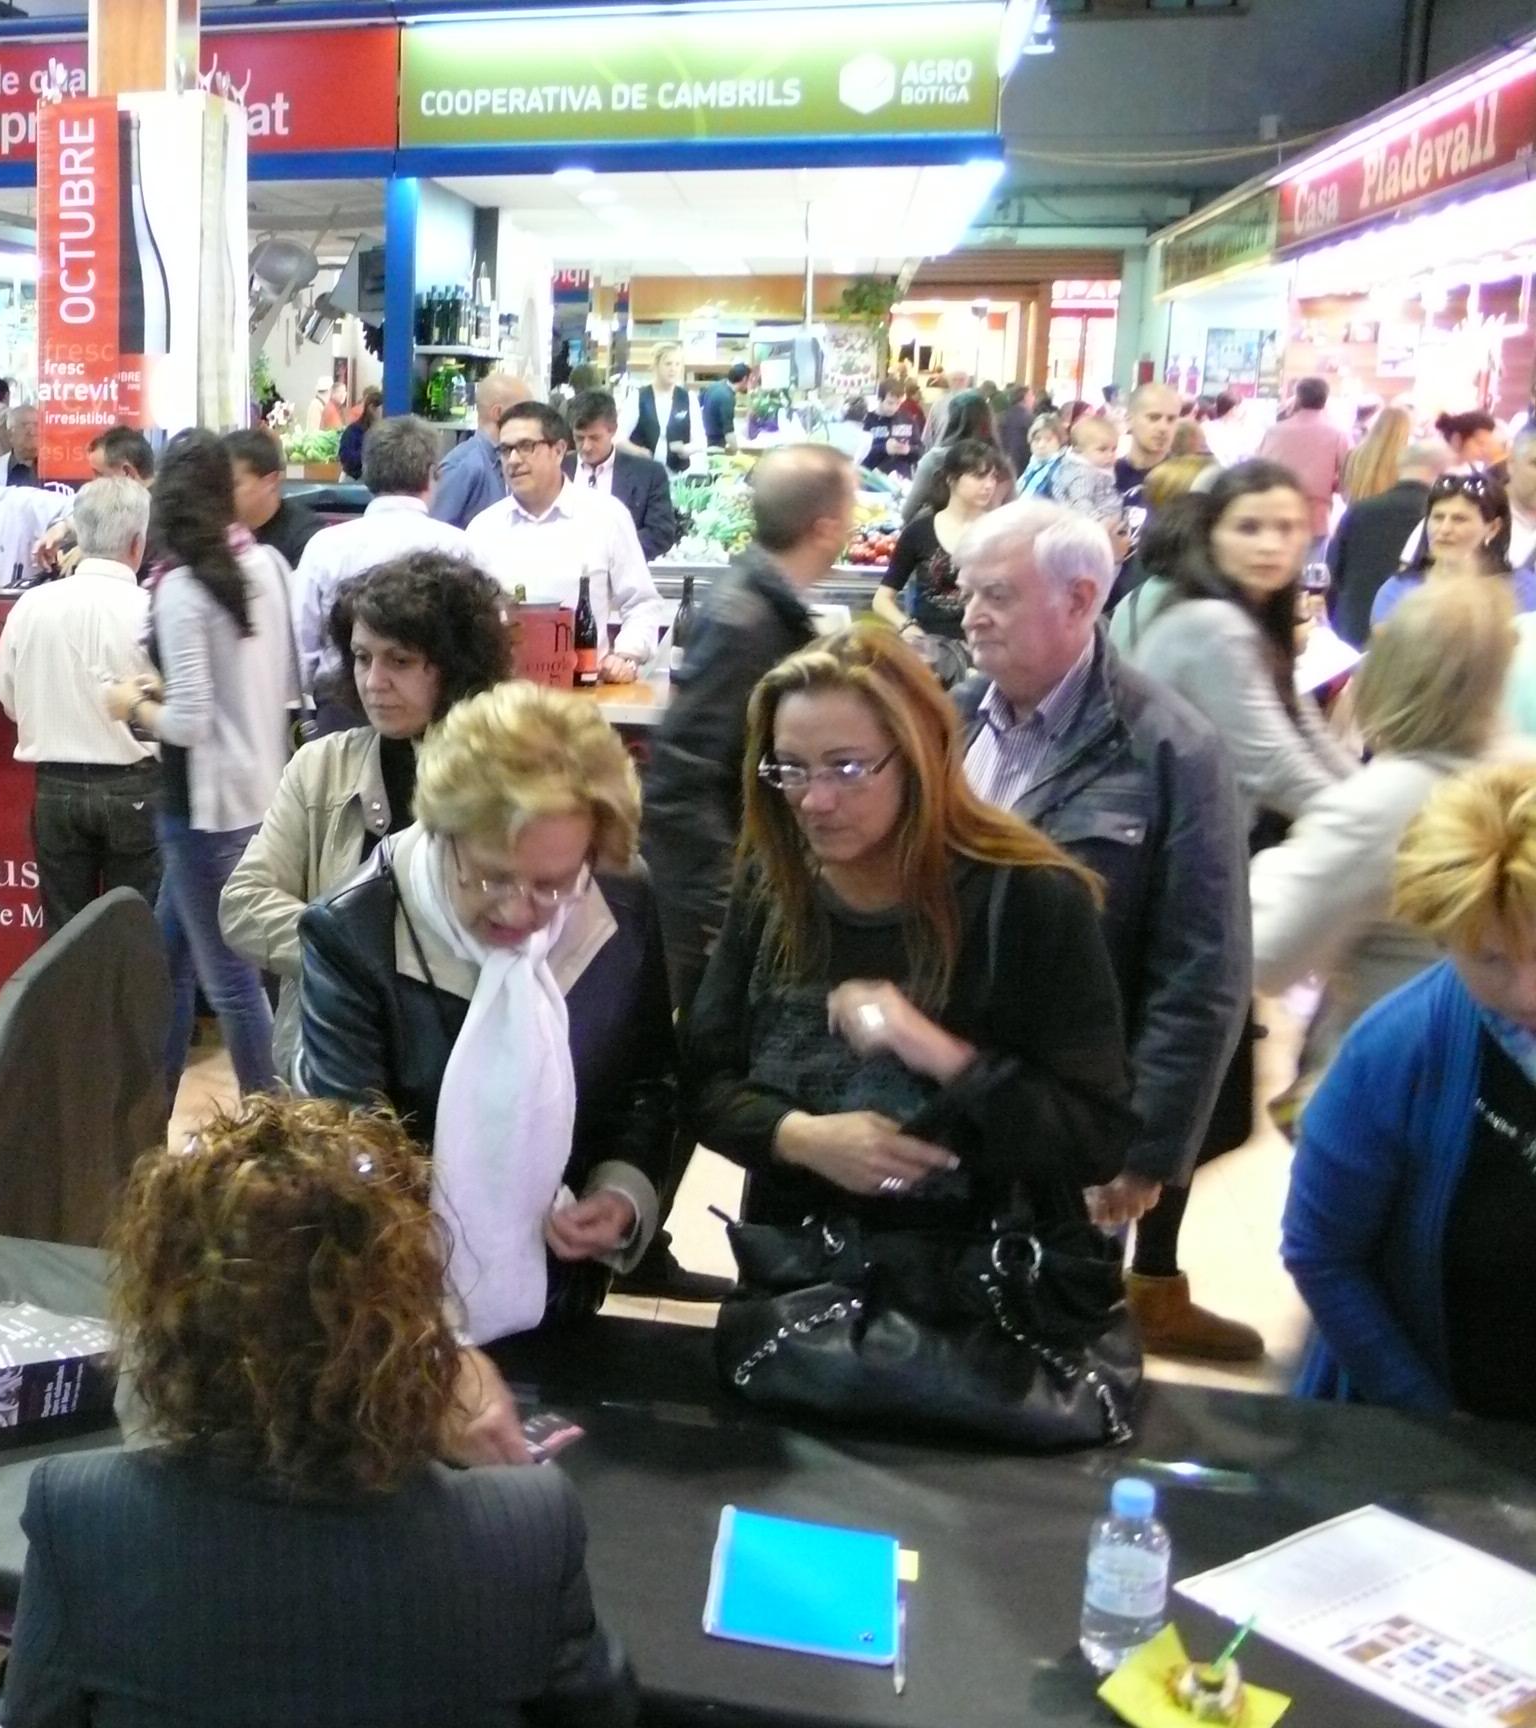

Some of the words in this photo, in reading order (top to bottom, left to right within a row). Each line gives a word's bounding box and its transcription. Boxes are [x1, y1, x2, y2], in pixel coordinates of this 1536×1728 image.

[901, 59, 972, 85] AGRO
[420, 84, 602, 116] COOPERATIVA
[611, 83, 647, 111] DE
[657, 78, 801, 109] CAMBRILS
[900, 85, 971, 105] BOTIGA
[1294, 183, 1340, 235] Casa
[1359, 90, 1500, 210] Pladevall
[59, 117, 96, 325] OCTUBRE
[44, 359, 85, 376] fresc
[38, 377, 119, 402] atrevit
[45, 411, 116, 425] irresistible
